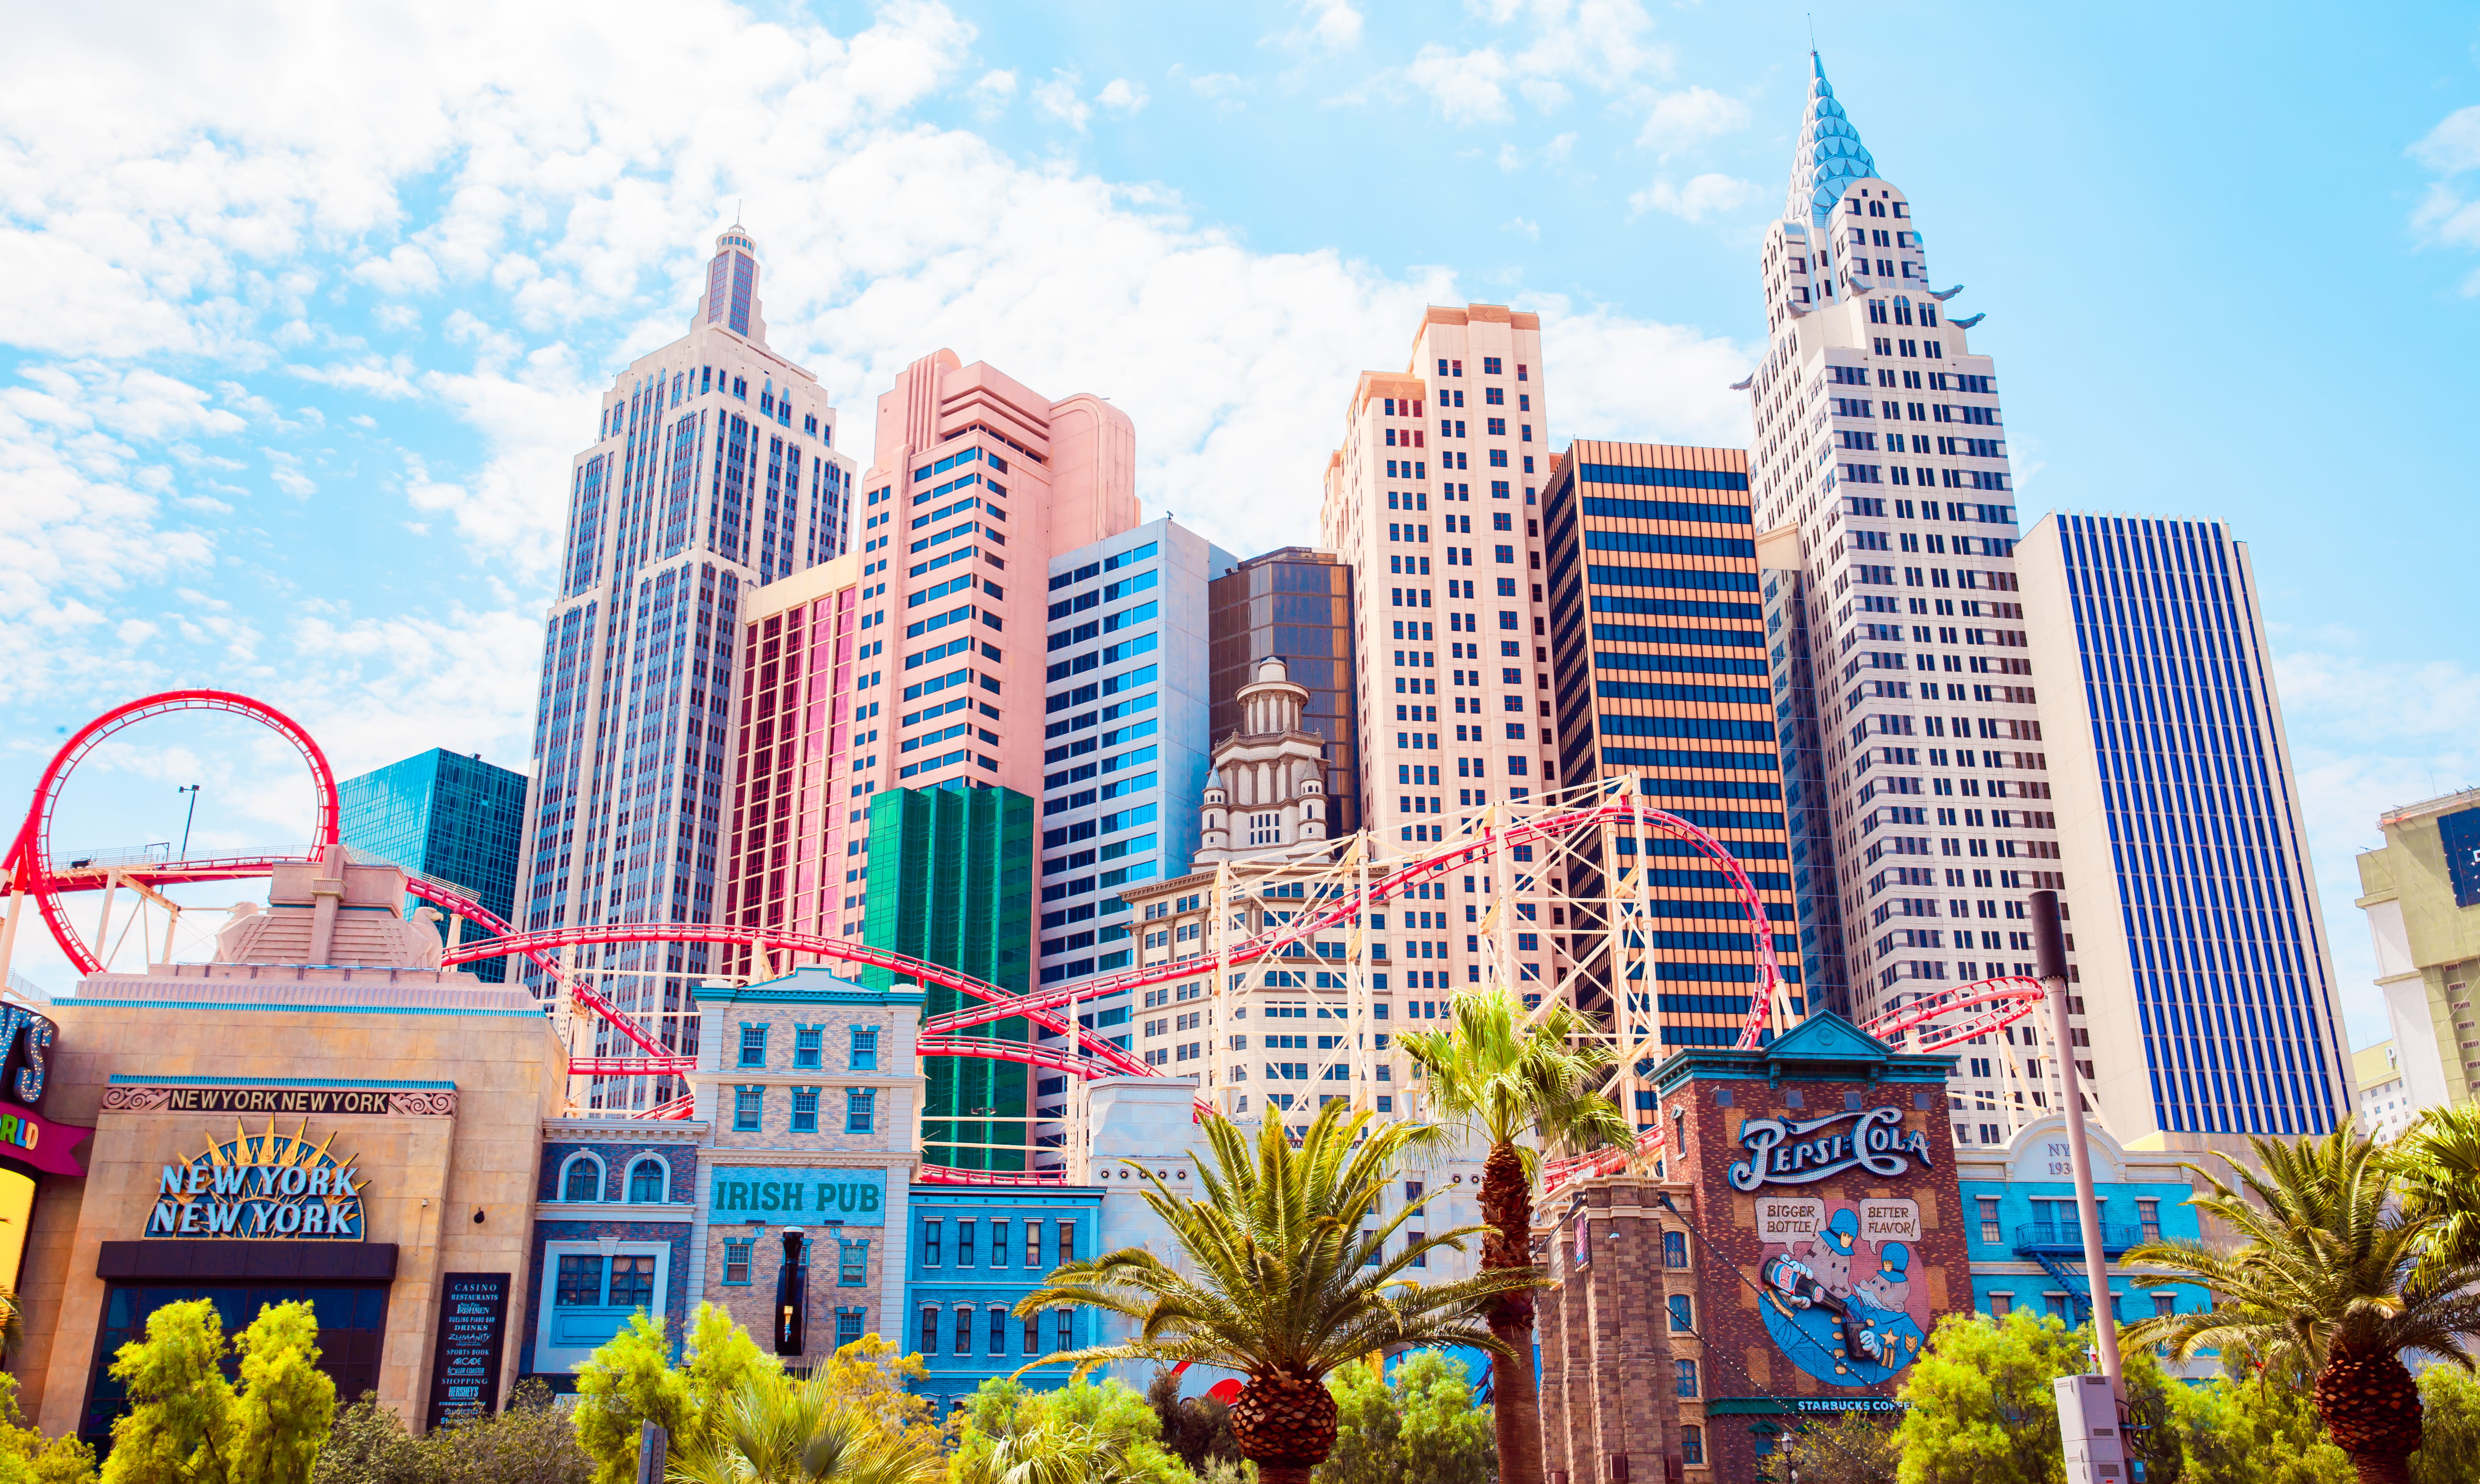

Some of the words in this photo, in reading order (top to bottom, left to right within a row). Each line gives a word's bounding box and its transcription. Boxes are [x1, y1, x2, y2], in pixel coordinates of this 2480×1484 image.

[0, 1114, 39, 1150] RLD
[2048, 1162, 2073, 1175] 193
[158, 1164, 250, 1195] NEW
[258, 1166, 360, 1196] YORK
[716, 1181, 804, 1211] IRISH
[816, 1183, 879, 1212] PUB
[151, 1202, 243, 1233] NEW
[251, 1203, 354, 1234] YORK
[1767, 1205, 1815, 1217] BIGGER
[1868, 1207, 1909, 1217] BETTER
[1767, 1218, 1819, 1236] BOTTLE!
[1869, 1219, 1915, 1237] FLAVOR!
[448, 1332, 492, 1343] ZUMANITY
[449, 1386, 479, 1397] HERSHEY'S
[1798, 1401, 1870, 1410] STARBUCKS
